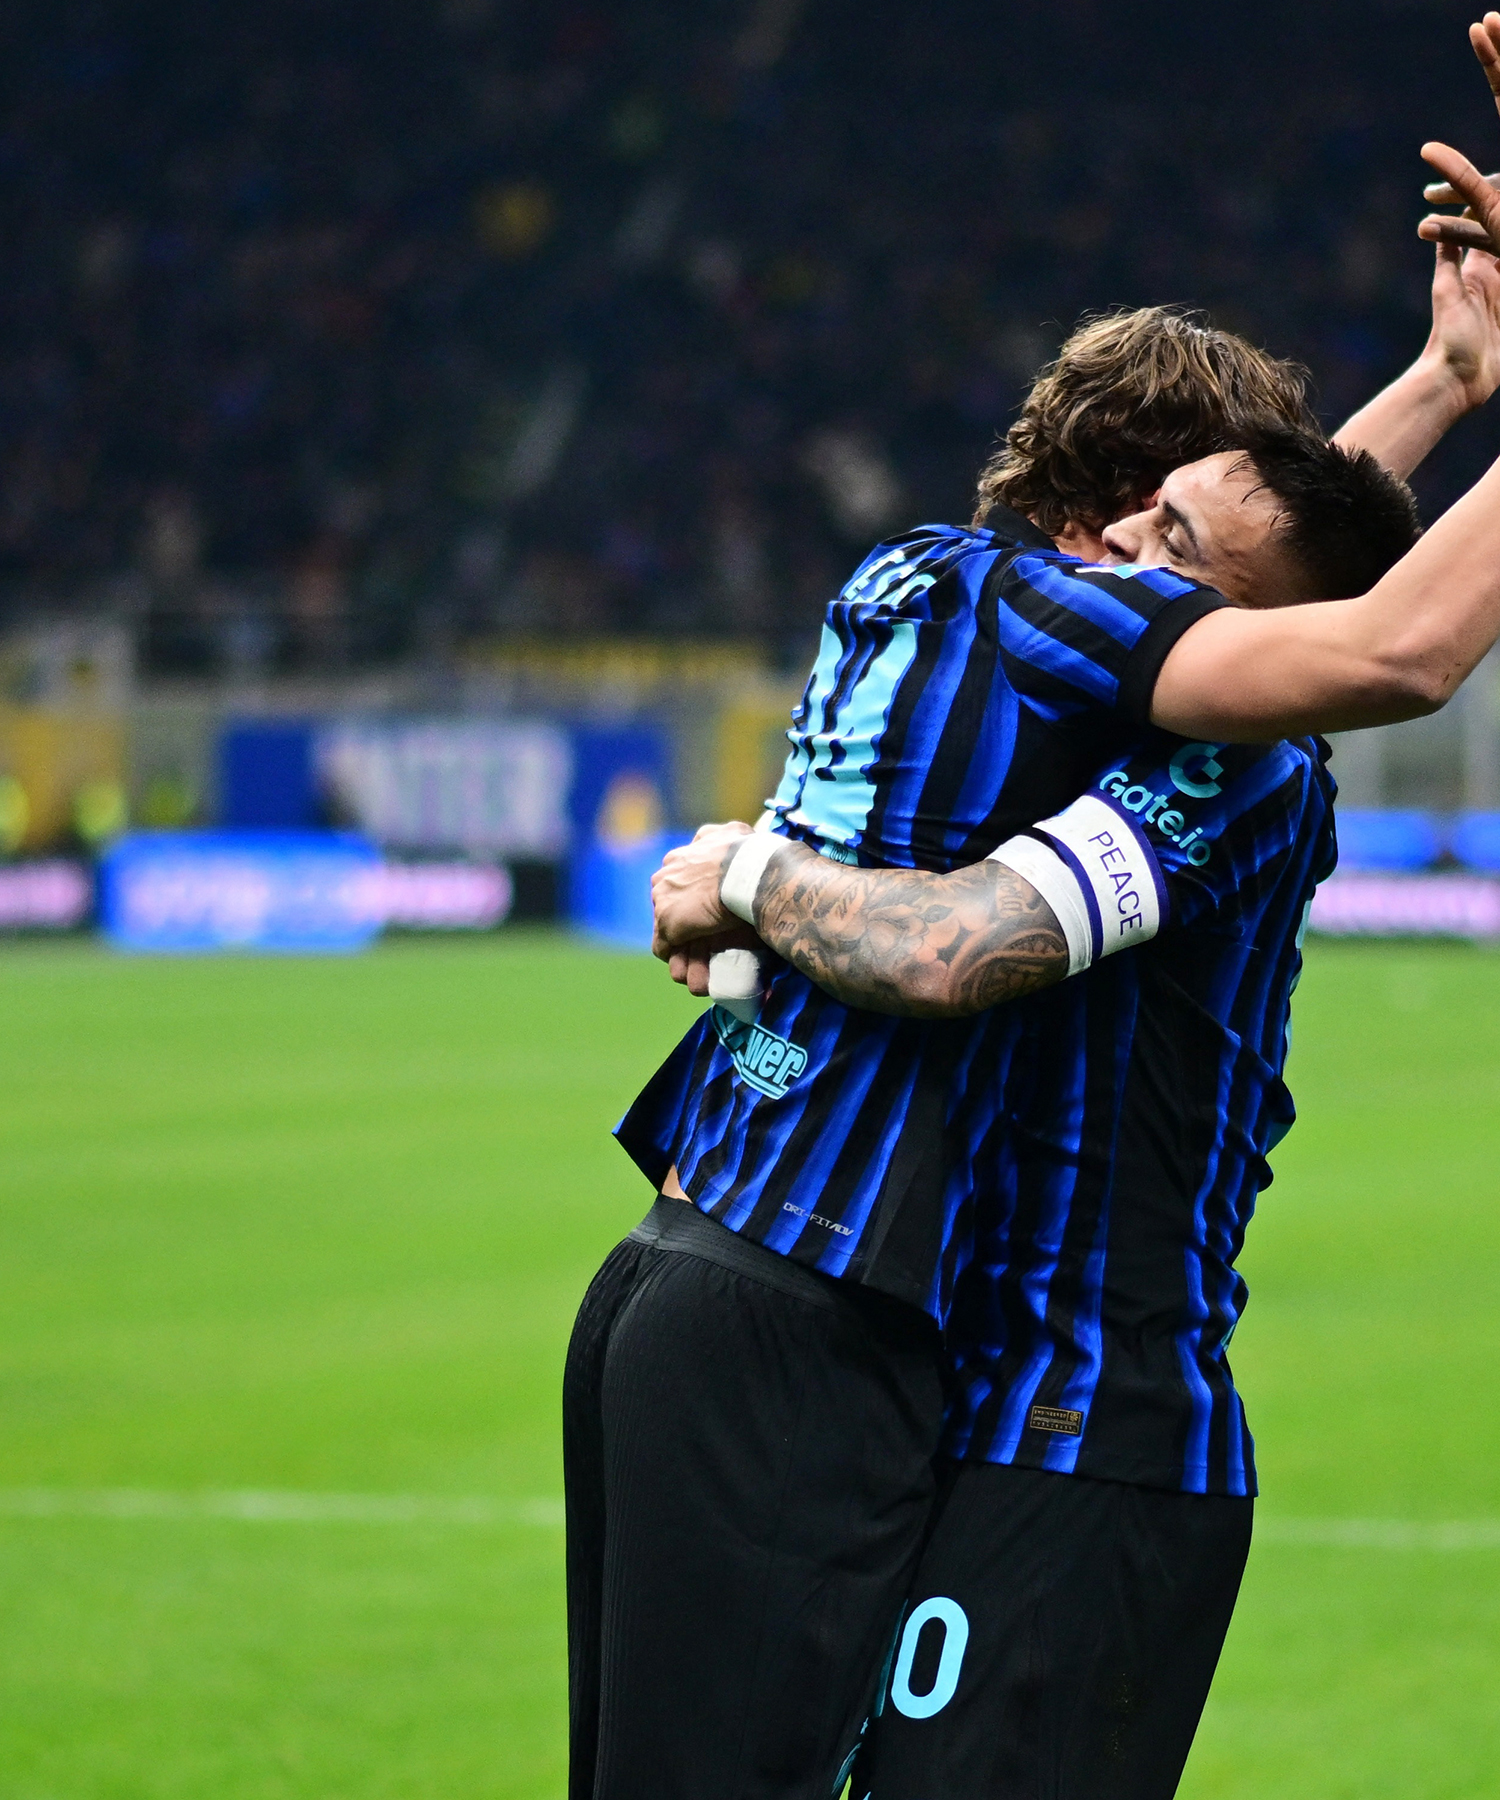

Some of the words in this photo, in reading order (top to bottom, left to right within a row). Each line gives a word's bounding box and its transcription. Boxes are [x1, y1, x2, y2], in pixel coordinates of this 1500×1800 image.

[1099, 771, 1211, 867] Gate.io
[1087, 830, 1143, 936] PEACE
[877, 1595, 970, 1720] 0
